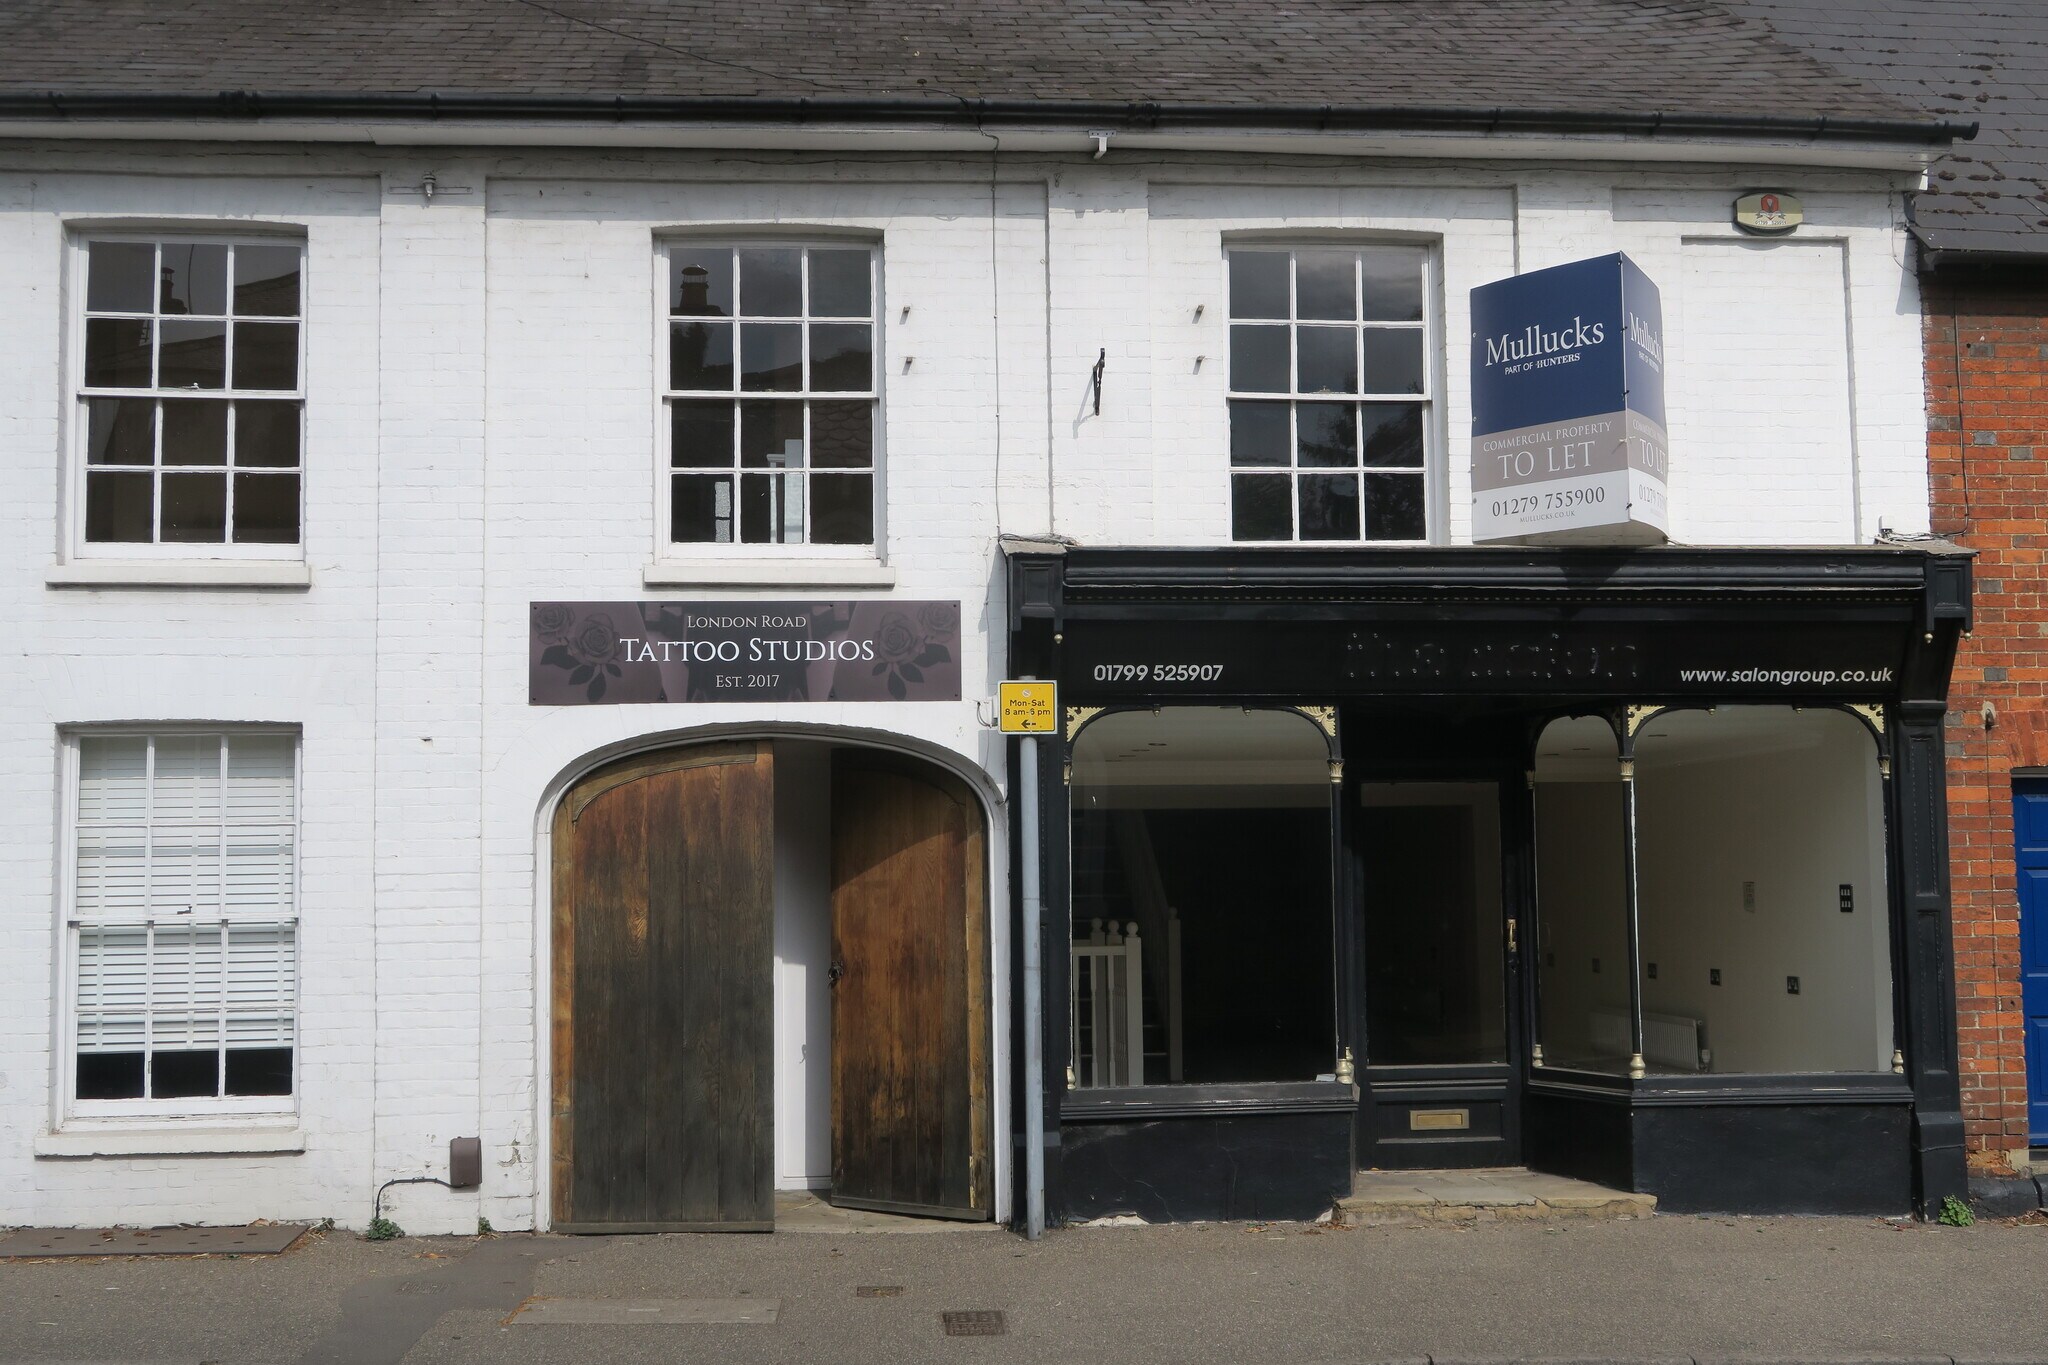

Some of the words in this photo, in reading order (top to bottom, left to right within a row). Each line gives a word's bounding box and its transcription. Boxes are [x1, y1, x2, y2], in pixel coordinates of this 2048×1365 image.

[1485, 315, 1605, 367] Mullucks
[1504, 364, 1521, 375] PART
[1523, 361, 1534, 371] OF
[1536, 352, 1581, 368] HUNTERS
[1483, 431, 1553, 452] COMMERCIAL
[1556, 421, 1612, 440] PROPERTY
[1497, 451, 1534, 480] TO
[1546, 440, 1596, 472] LET
[1640, 438, 1654, 468] TO
[1492, 495, 1538, 517] 01279
[1544, 486, 1605, 509] 755900
[1519, 510, 1575, 523] MULLUCKS.CO.UK
[687, 615, 757, 628] LONDON
[761, 615, 807, 628] ROAD
[619, 638, 740, 662] TATTOO
[749, 637, 874, 662] STUDIOS
[747, 674, 780, 688] 2017
[1094, 664, 1149, 681] 01799
[1152, 664, 1224, 681] 525907
[1680, 667, 1893, 685] www.salongroup.co.uk
[1004, 708, 1011, 716] 8
[1009, 699, 1046, 707] Mon-Sat
